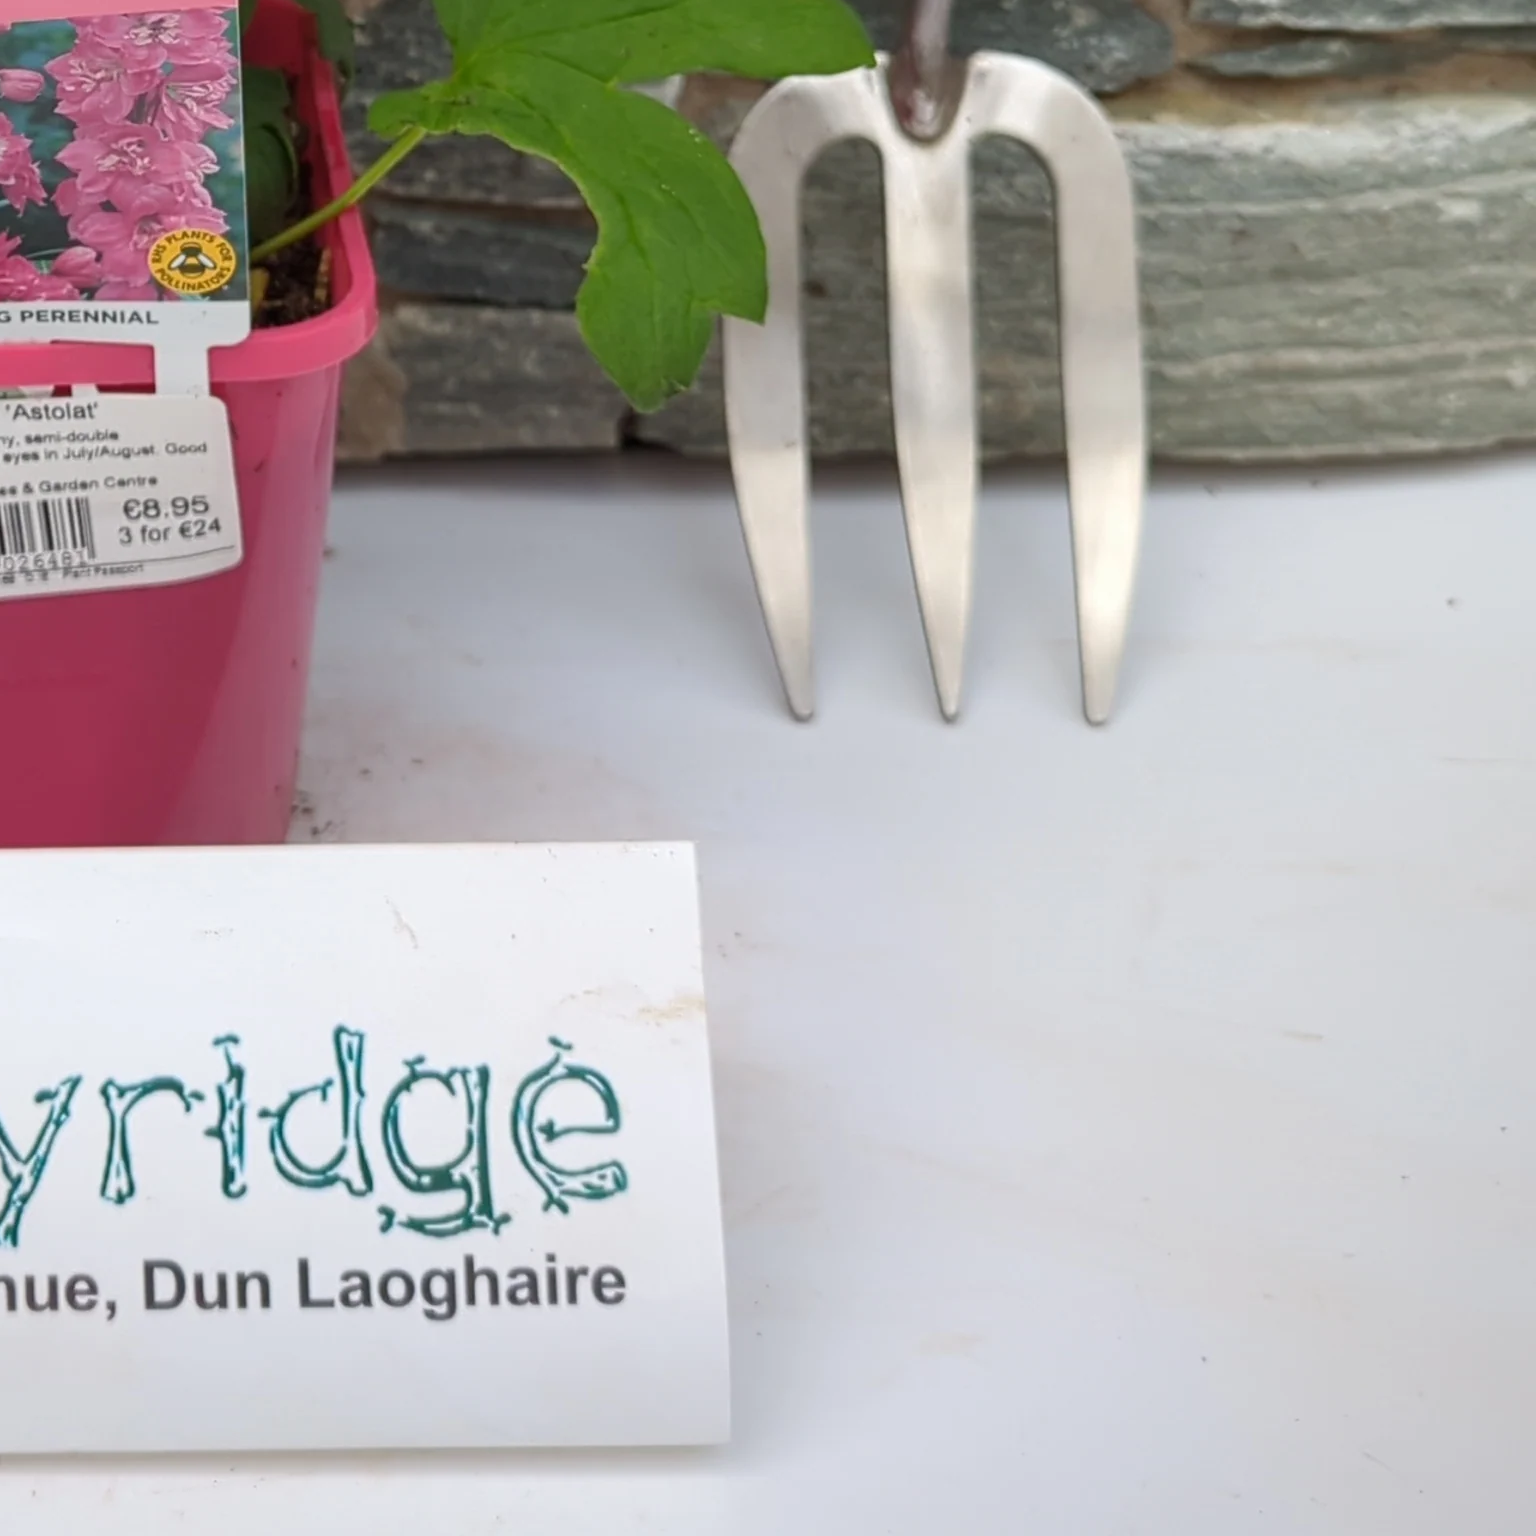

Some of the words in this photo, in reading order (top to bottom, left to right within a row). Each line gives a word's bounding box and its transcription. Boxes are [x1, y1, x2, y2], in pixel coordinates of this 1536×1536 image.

[165, 230, 217, 245] PLANTS
[215, 242, 233, 261] FOR
[155, 267, 231, 291] POLLINATORS
[20, 309, 159, 325] PERENNIAL
[25, 429, 119, 445] semi-double
[3, 448, 40, 464] eyes
[44, 445, 59, 460] in
[164, 442, 208, 455] Good
[22, 481, 34, 495] &
[38, 476, 99, 494] Garden
[103, 474, 159, 490] Centre
[122, 495, 210, 521] €8.95
[118, 526, 133, 545] 3
[140, 524, 171, 544] for
[178, 517, 222, 541] €24
[141, 1260, 271, 1311] Dun
[297, 1254, 627, 1322] Laoghaire
